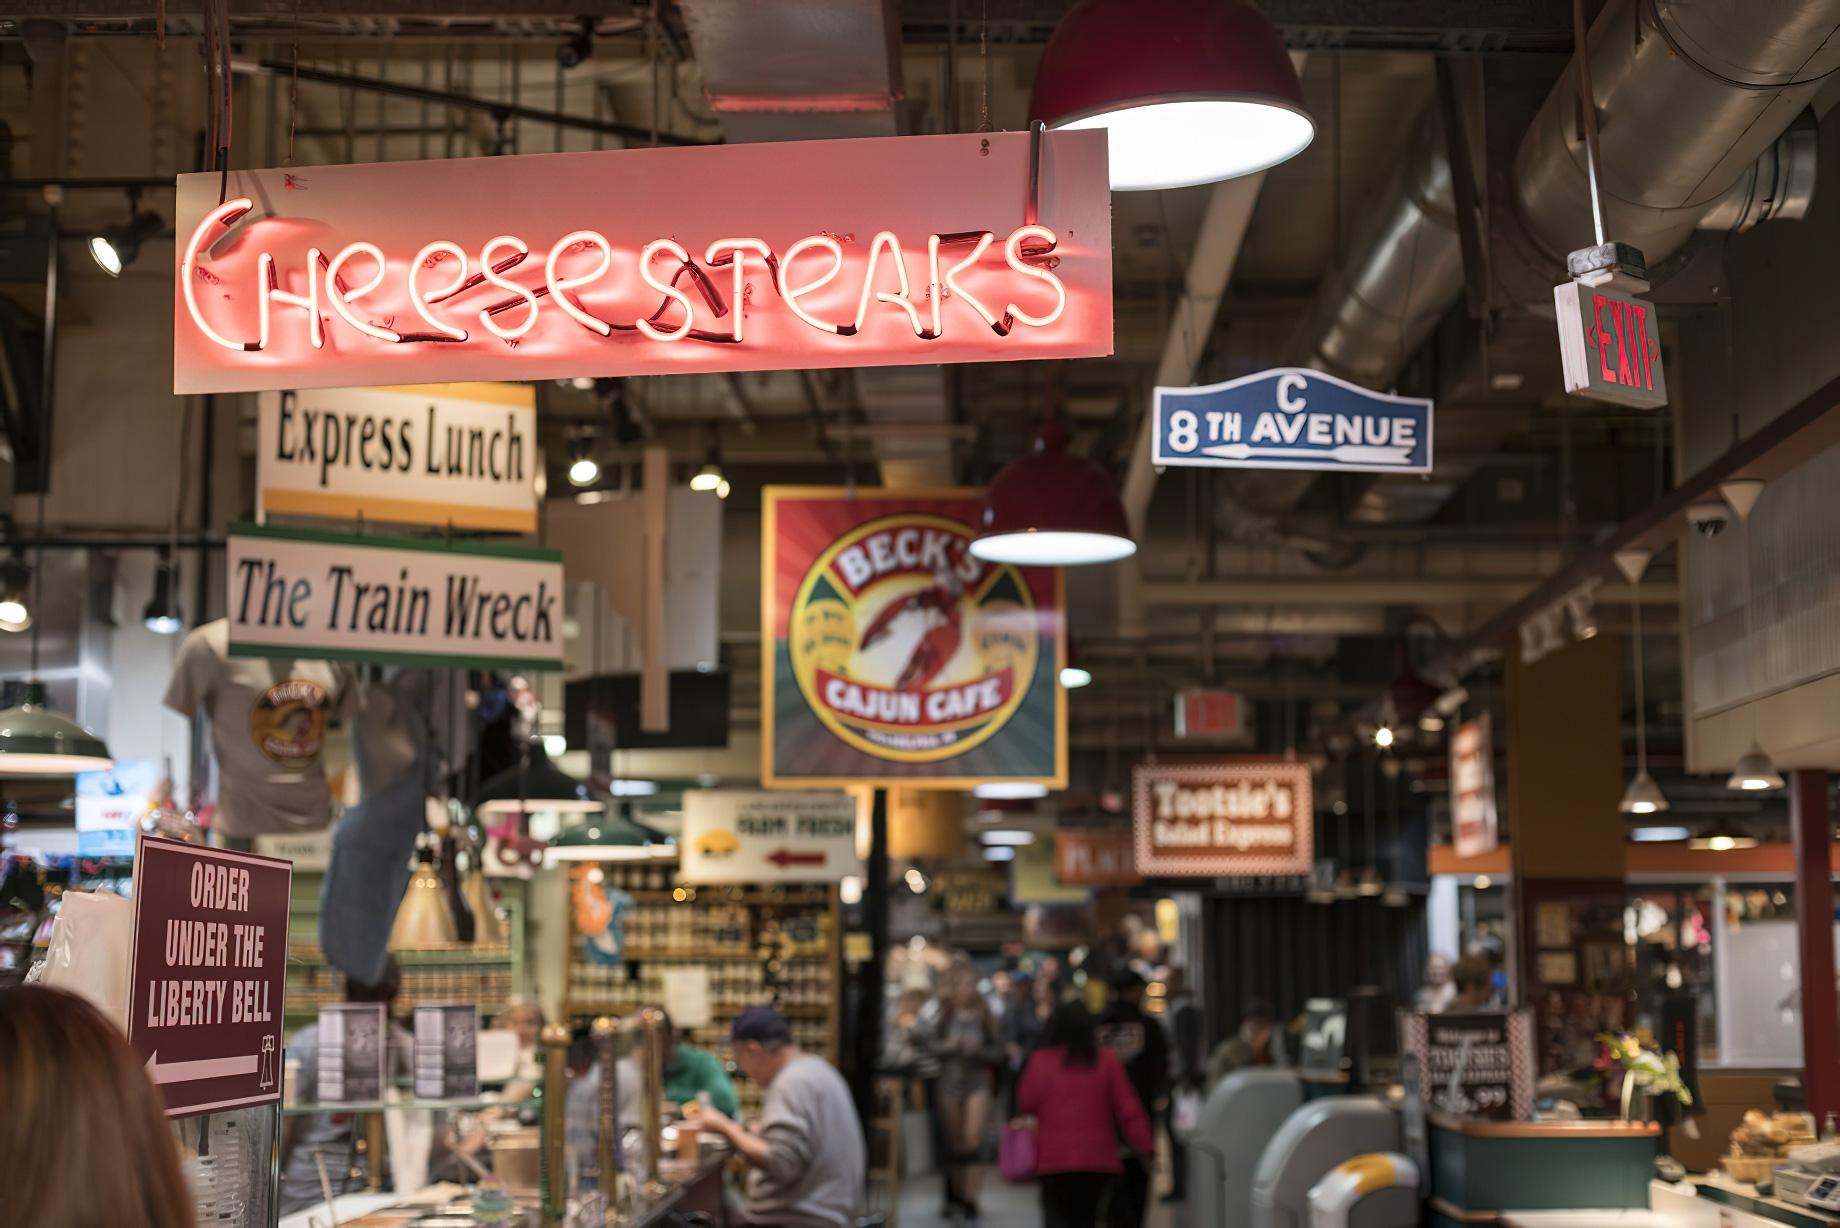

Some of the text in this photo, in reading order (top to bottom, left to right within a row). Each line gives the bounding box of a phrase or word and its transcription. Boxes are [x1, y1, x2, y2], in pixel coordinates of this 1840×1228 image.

[1594, 294, 1652, 391] EXIT
[1276, 374, 1308, 413] C
[277, 391, 523, 488] Express Lunch
[1250, 412, 1417, 447] AVENUE
[236, 558, 556, 643] The Train Wreck
[825, 677, 1004, 723] CAJUN CAFE
[190, 861, 250, 912] ORDER
[165, 919, 265, 968] UNDER THE
[147, 980, 271, 1028] LIBERTY BELL
